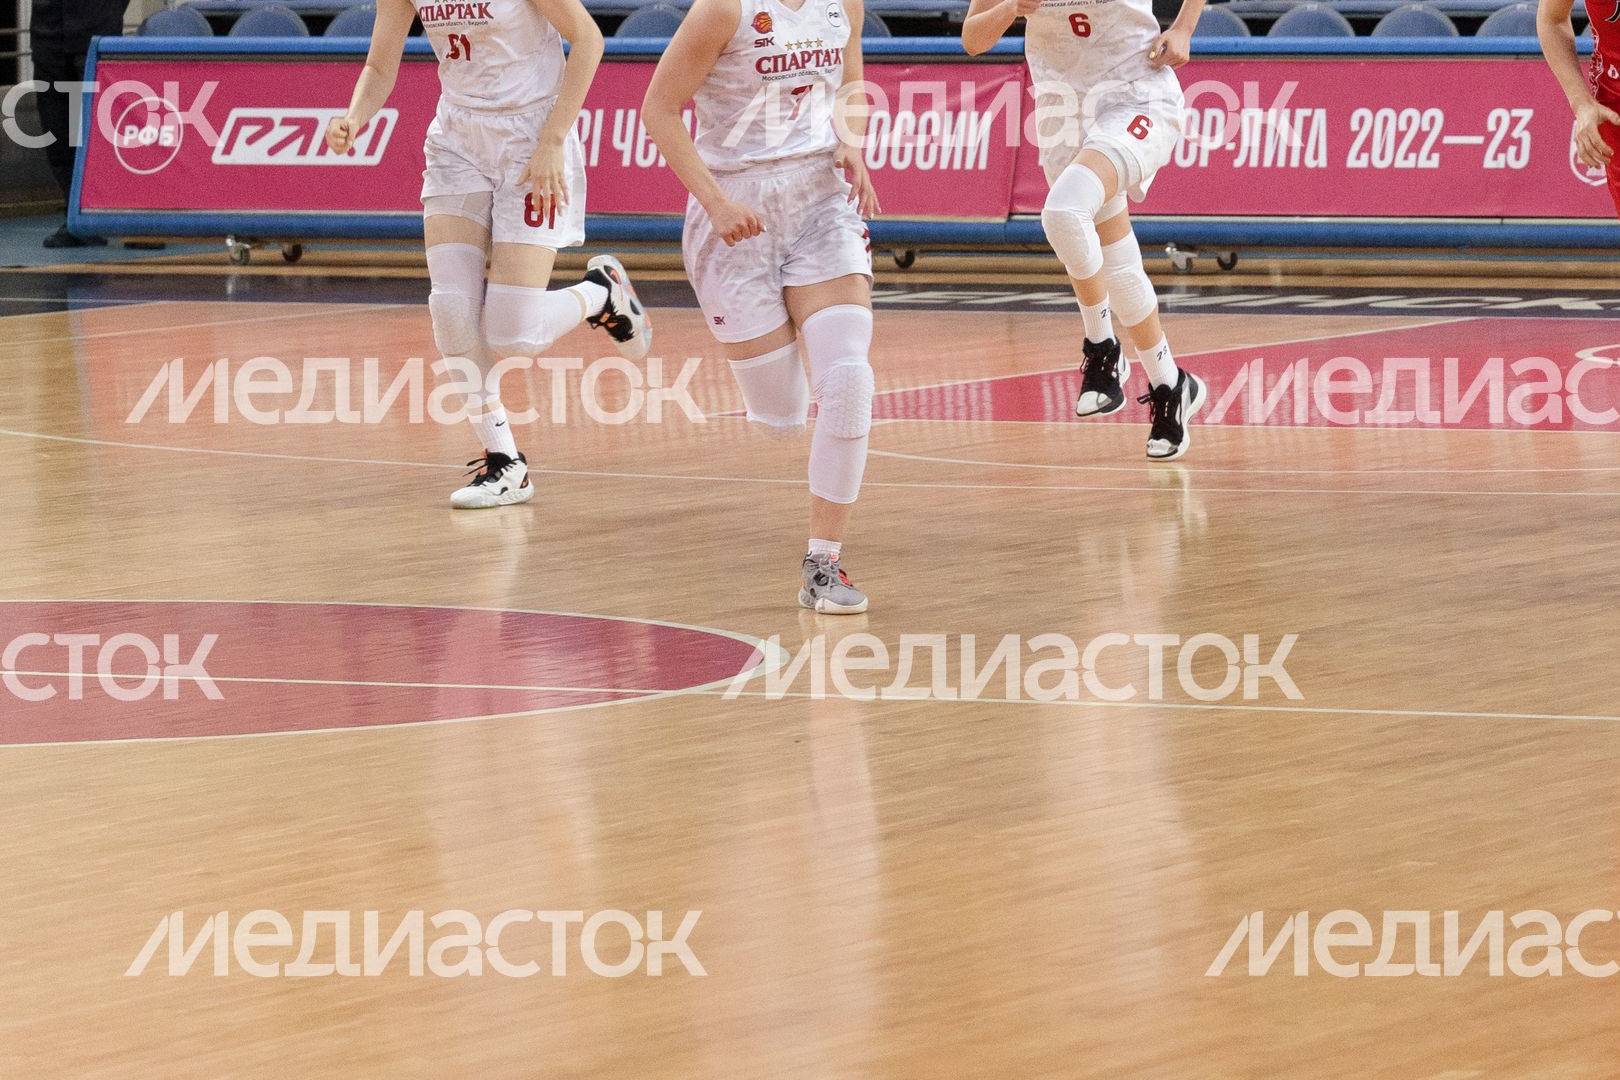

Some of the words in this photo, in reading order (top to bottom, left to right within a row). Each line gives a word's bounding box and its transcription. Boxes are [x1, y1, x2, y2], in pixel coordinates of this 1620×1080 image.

[420, 2, 494, 22] СПАРТАК
[1069, 13, 1092, 38] 6
[788, 85, 813, 121] 7
[123, 125, 175, 146] РФБ
[1127, 114, 1153, 140] 6
[865, 110, 992, 170] ОССИИ
